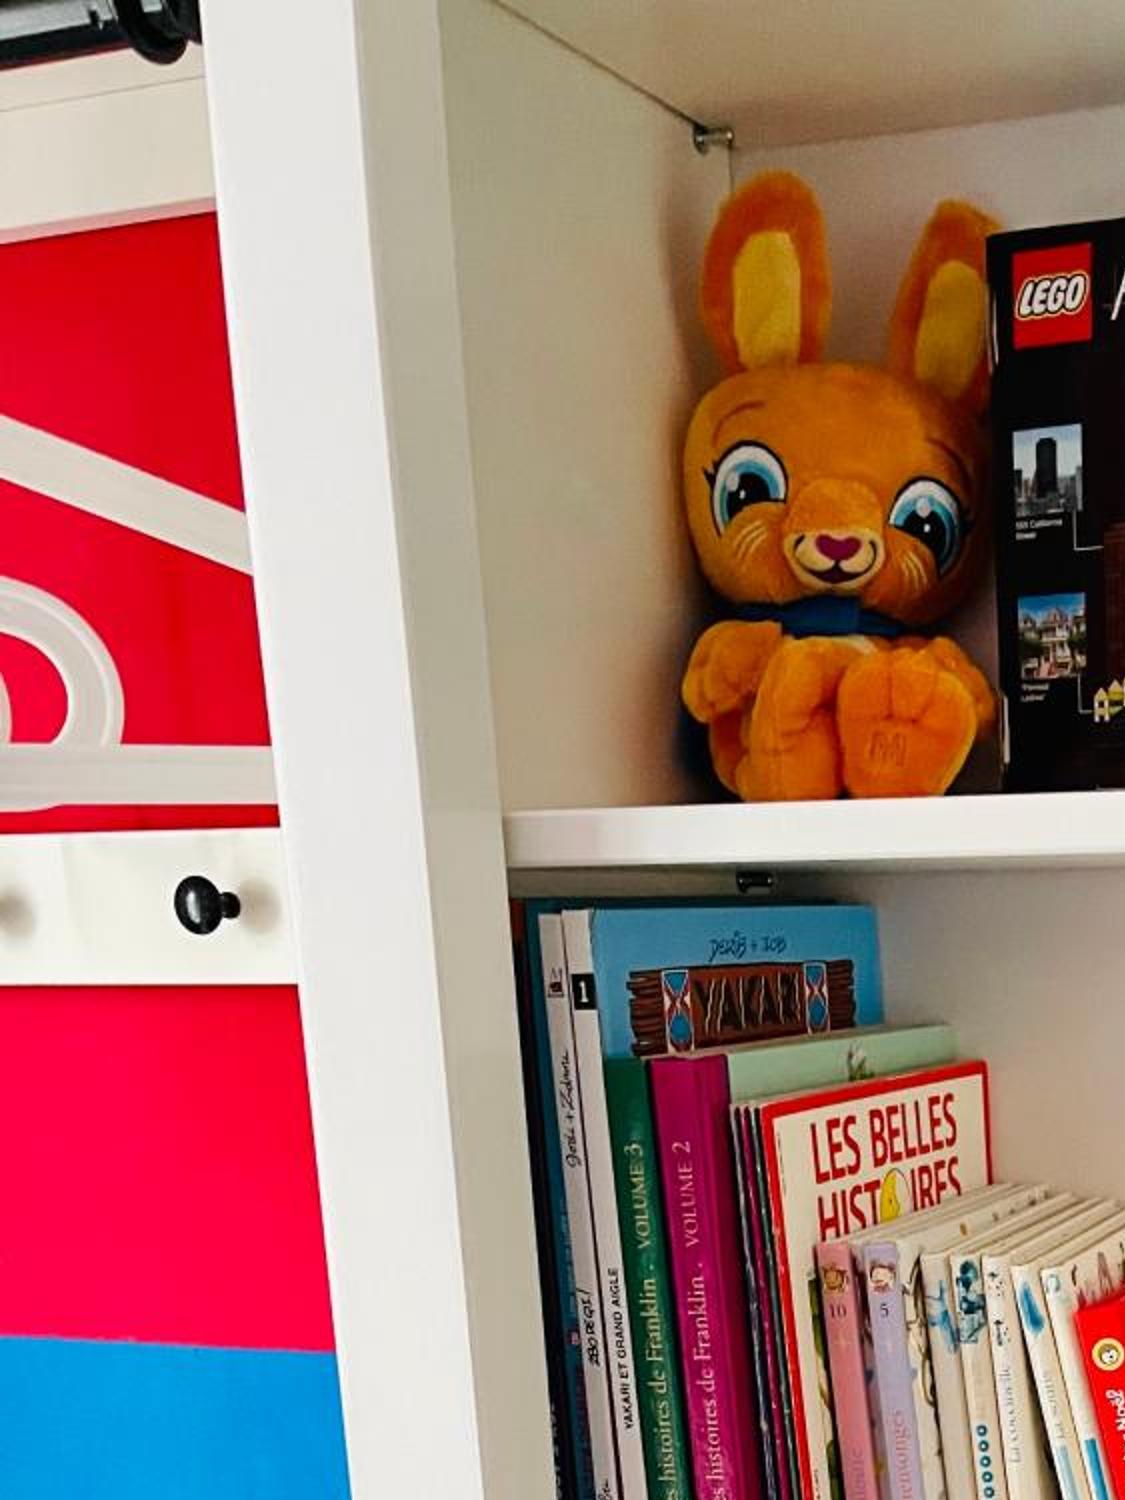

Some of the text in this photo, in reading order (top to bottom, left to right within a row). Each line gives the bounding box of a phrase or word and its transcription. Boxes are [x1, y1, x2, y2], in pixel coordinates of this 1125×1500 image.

[1016, 271, 1089, 321] LEGO
[579, 980, 589, 1003] 1
[624, 1142, 644, 1156] 3
[673, 1141, 692, 1154] 2
[809, 1092, 958, 1185] LES BELLES
[629, 1158, 652, 1250] VOLUME
[677, 1163, 700, 1250] VOLUME
[829, 1303, 847, 1318] 10
[880, 1303, 889, 1317] 5
[607, 1267, 634, 1430] YAKARI ET GRAND AIGLE
[646, 1369, 668, 1395] de
[695, 1368, 717, 1394] de
[653, 1399, 678, 1475] histoires
[700, 1400, 726, 1483] histoires
